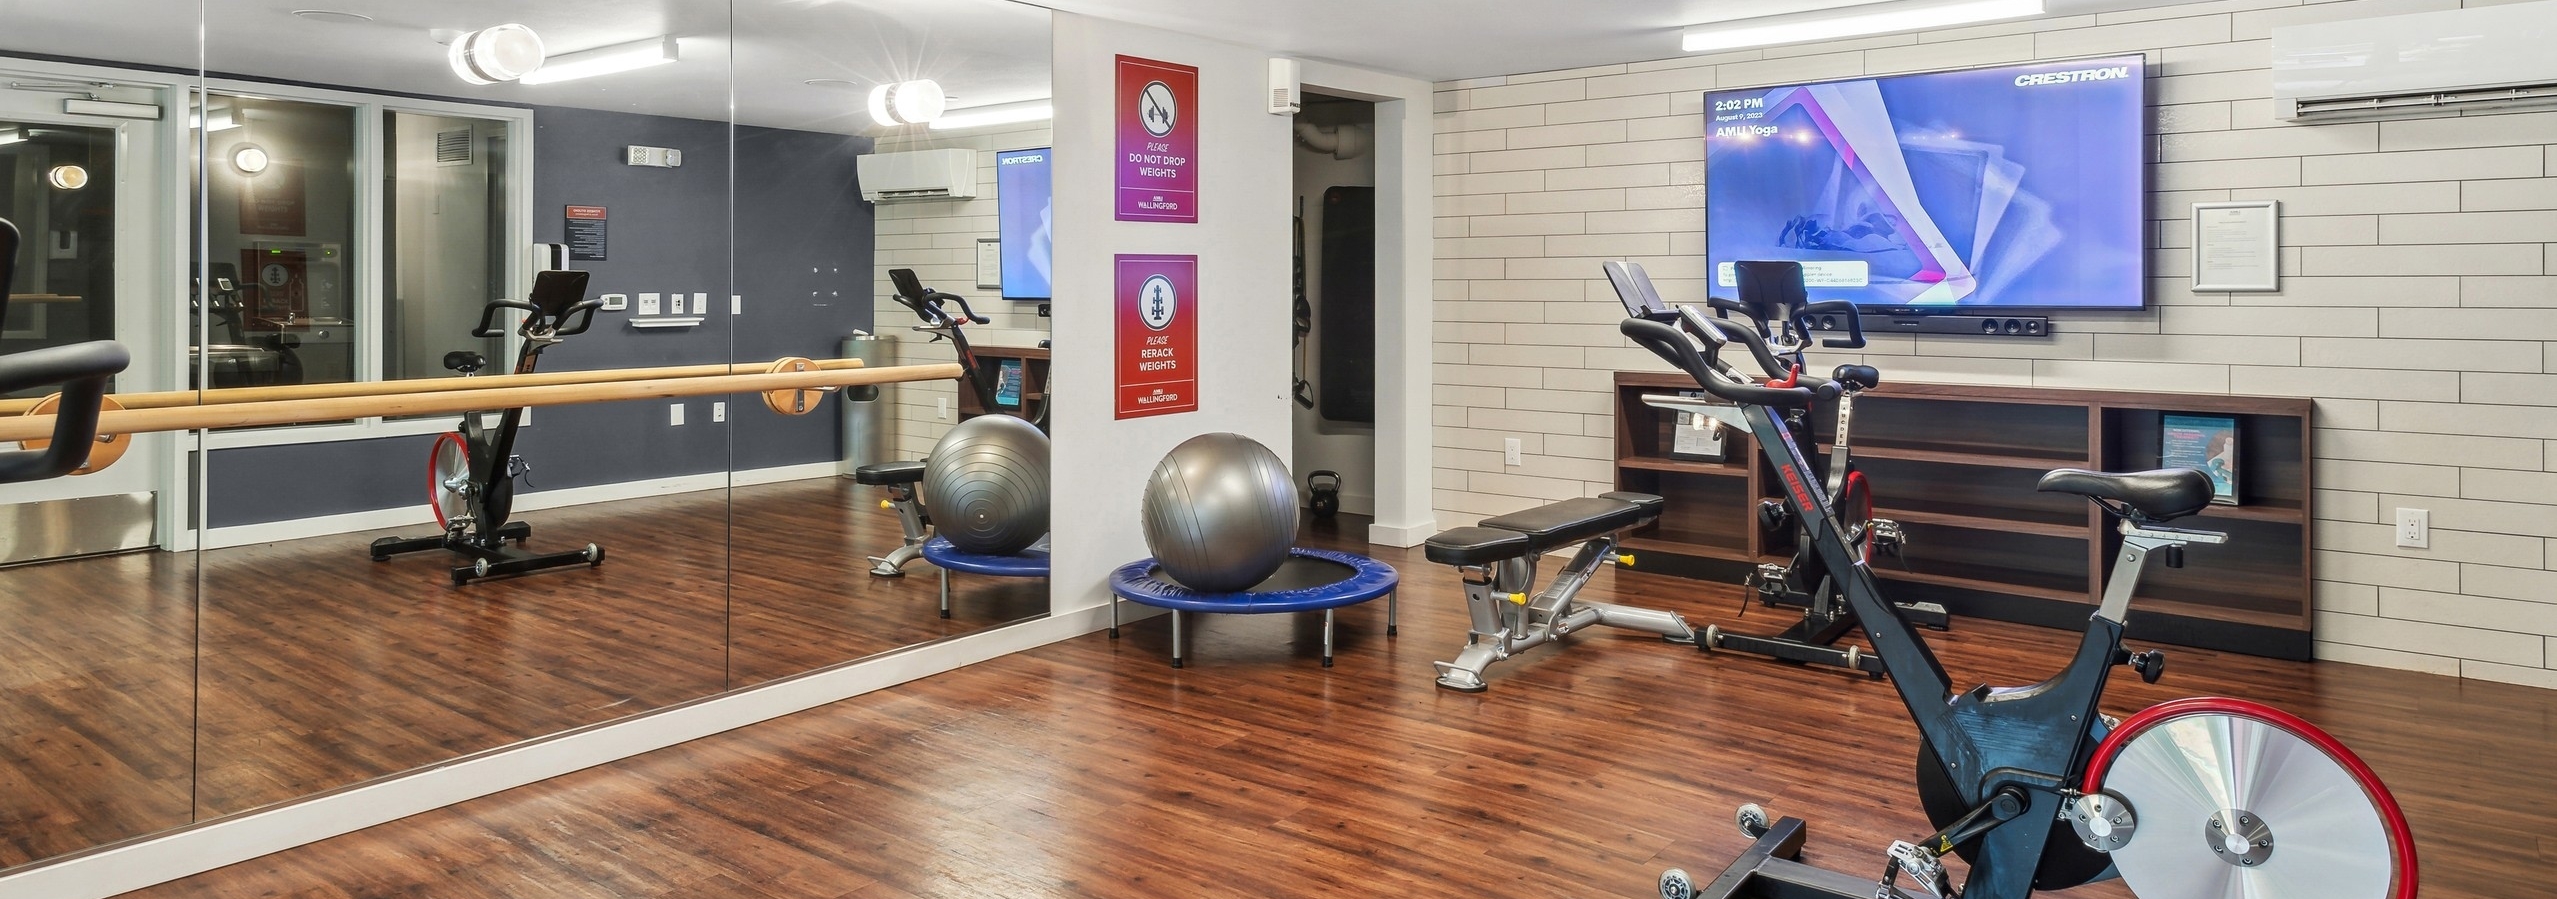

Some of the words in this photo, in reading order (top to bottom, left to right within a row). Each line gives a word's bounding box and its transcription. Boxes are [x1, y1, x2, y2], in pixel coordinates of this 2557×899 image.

[1715, 99, 1742, 111] 2:02
[1744, 97, 1764, 109] PM
[1716, 113, 1738, 122] August
[1749, 125, 1778, 137] Yoga
[1147, 142, 1169, 152] PLEASE
[1129, 153, 1142, 163] DO
[1144, 154, 1161, 164] NOT
[1163, 156, 1186, 166] DROP
[1139, 167, 1177, 178] WEIGHTS
[1137, 201, 1178, 210] WALLINGFORD
[1146, 335, 1169, 345] PLEASE
[1141, 348, 1174, 358] RERACK
[1139, 360, 1177, 371] WEIGHTS
[1137, 393, 1178, 404] WALLINGFORD
[1781, 463, 1814, 512] KEISER
